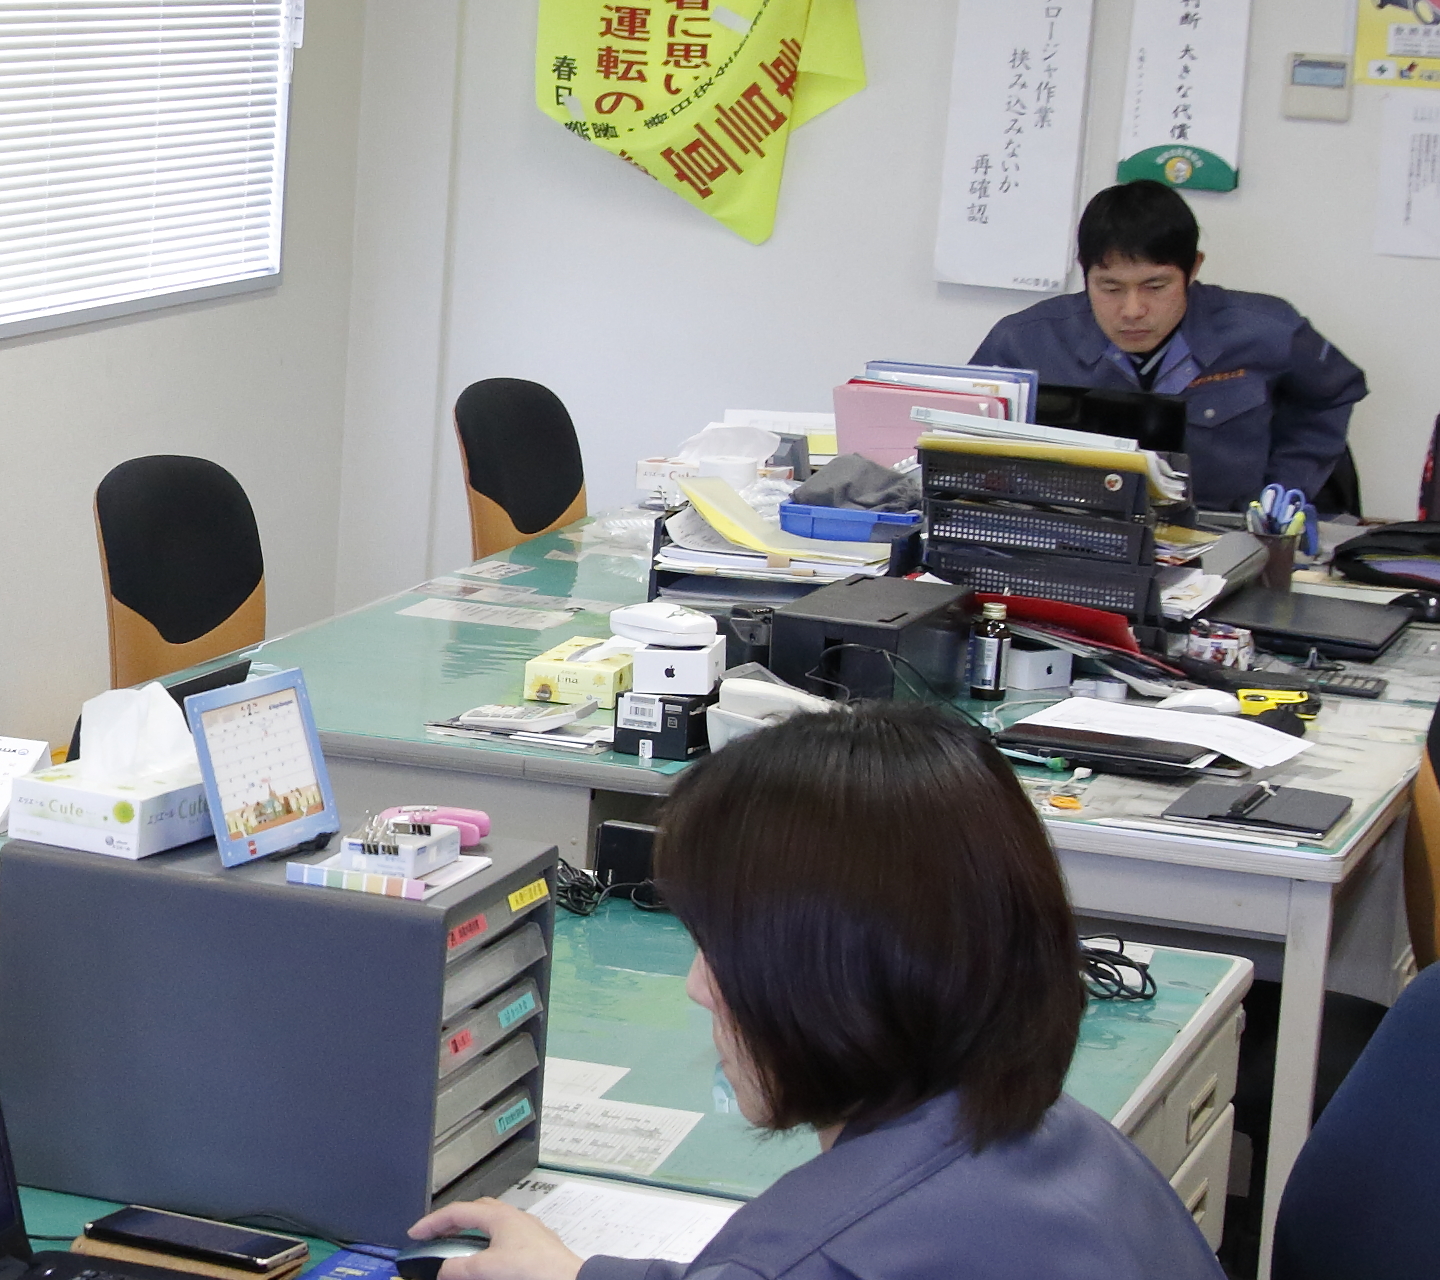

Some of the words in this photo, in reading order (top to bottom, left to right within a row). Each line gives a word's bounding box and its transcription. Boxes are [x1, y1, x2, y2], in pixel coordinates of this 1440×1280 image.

[998, 48, 1032, 194] 挟み込みないか
[966, 153, 995, 225] 再確認
[48, 799, 83, 817] Cute
